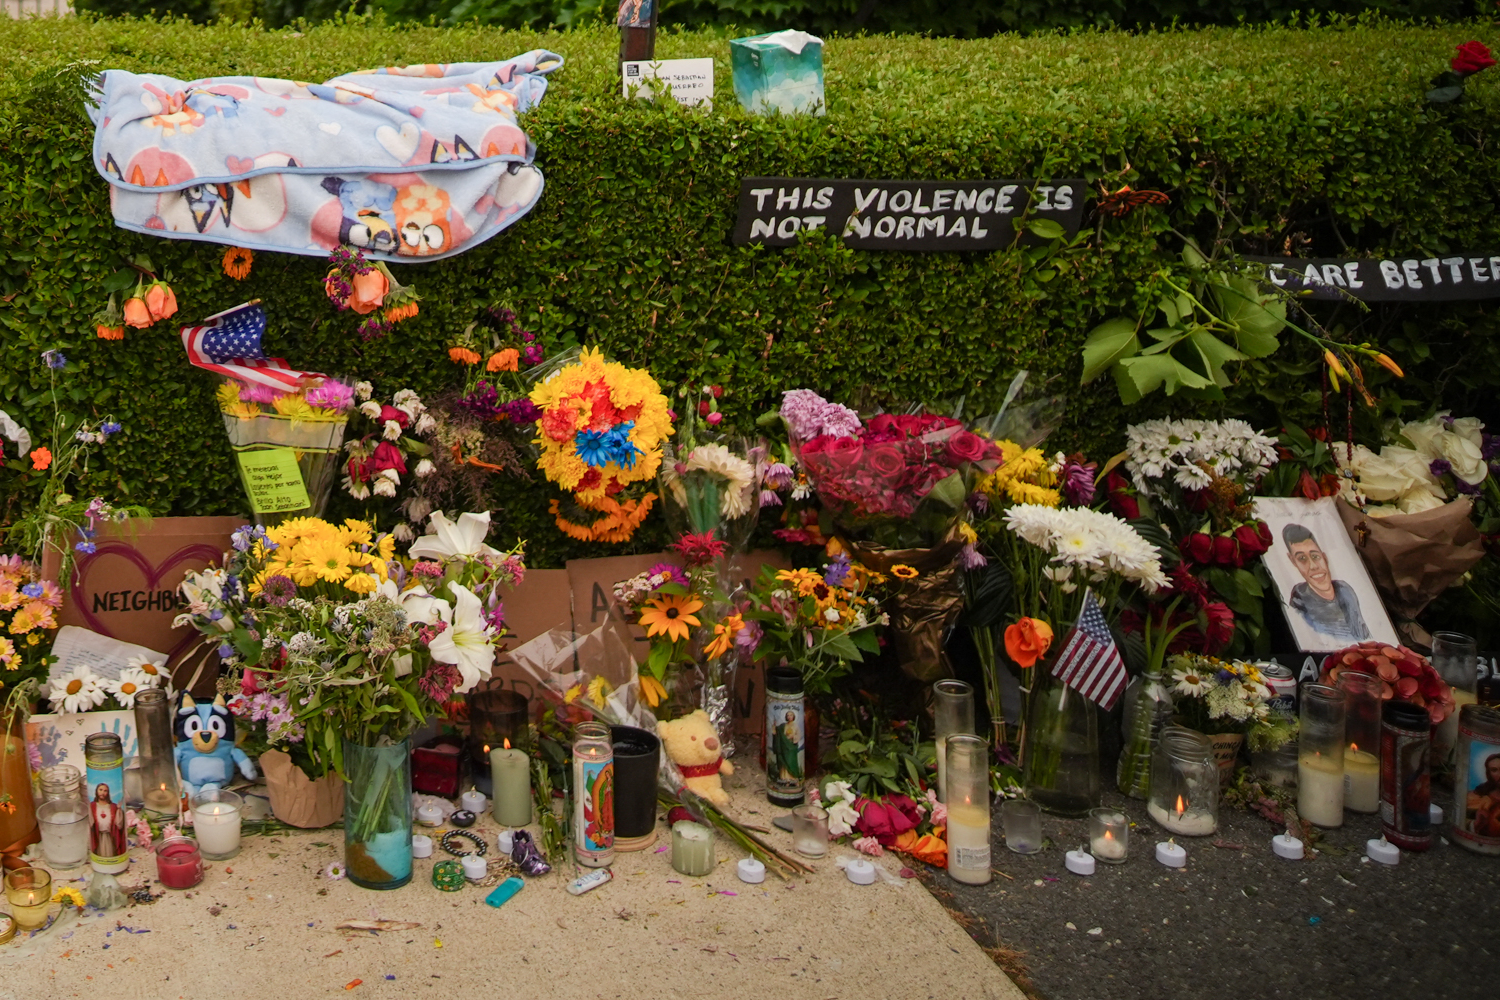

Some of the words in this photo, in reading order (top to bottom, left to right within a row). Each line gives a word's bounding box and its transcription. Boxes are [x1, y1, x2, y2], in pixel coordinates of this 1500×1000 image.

[749, 186, 835, 212] THIS
[854, 185, 1019, 213] VIOLENCE
[1035, 185, 1074, 211] IS
[749, 214, 827, 240] NOT
[843, 214, 989, 241] NORMAL
[1302, 260, 1364, 290] ARE
[1272, 698, 1293, 709] Pabst
